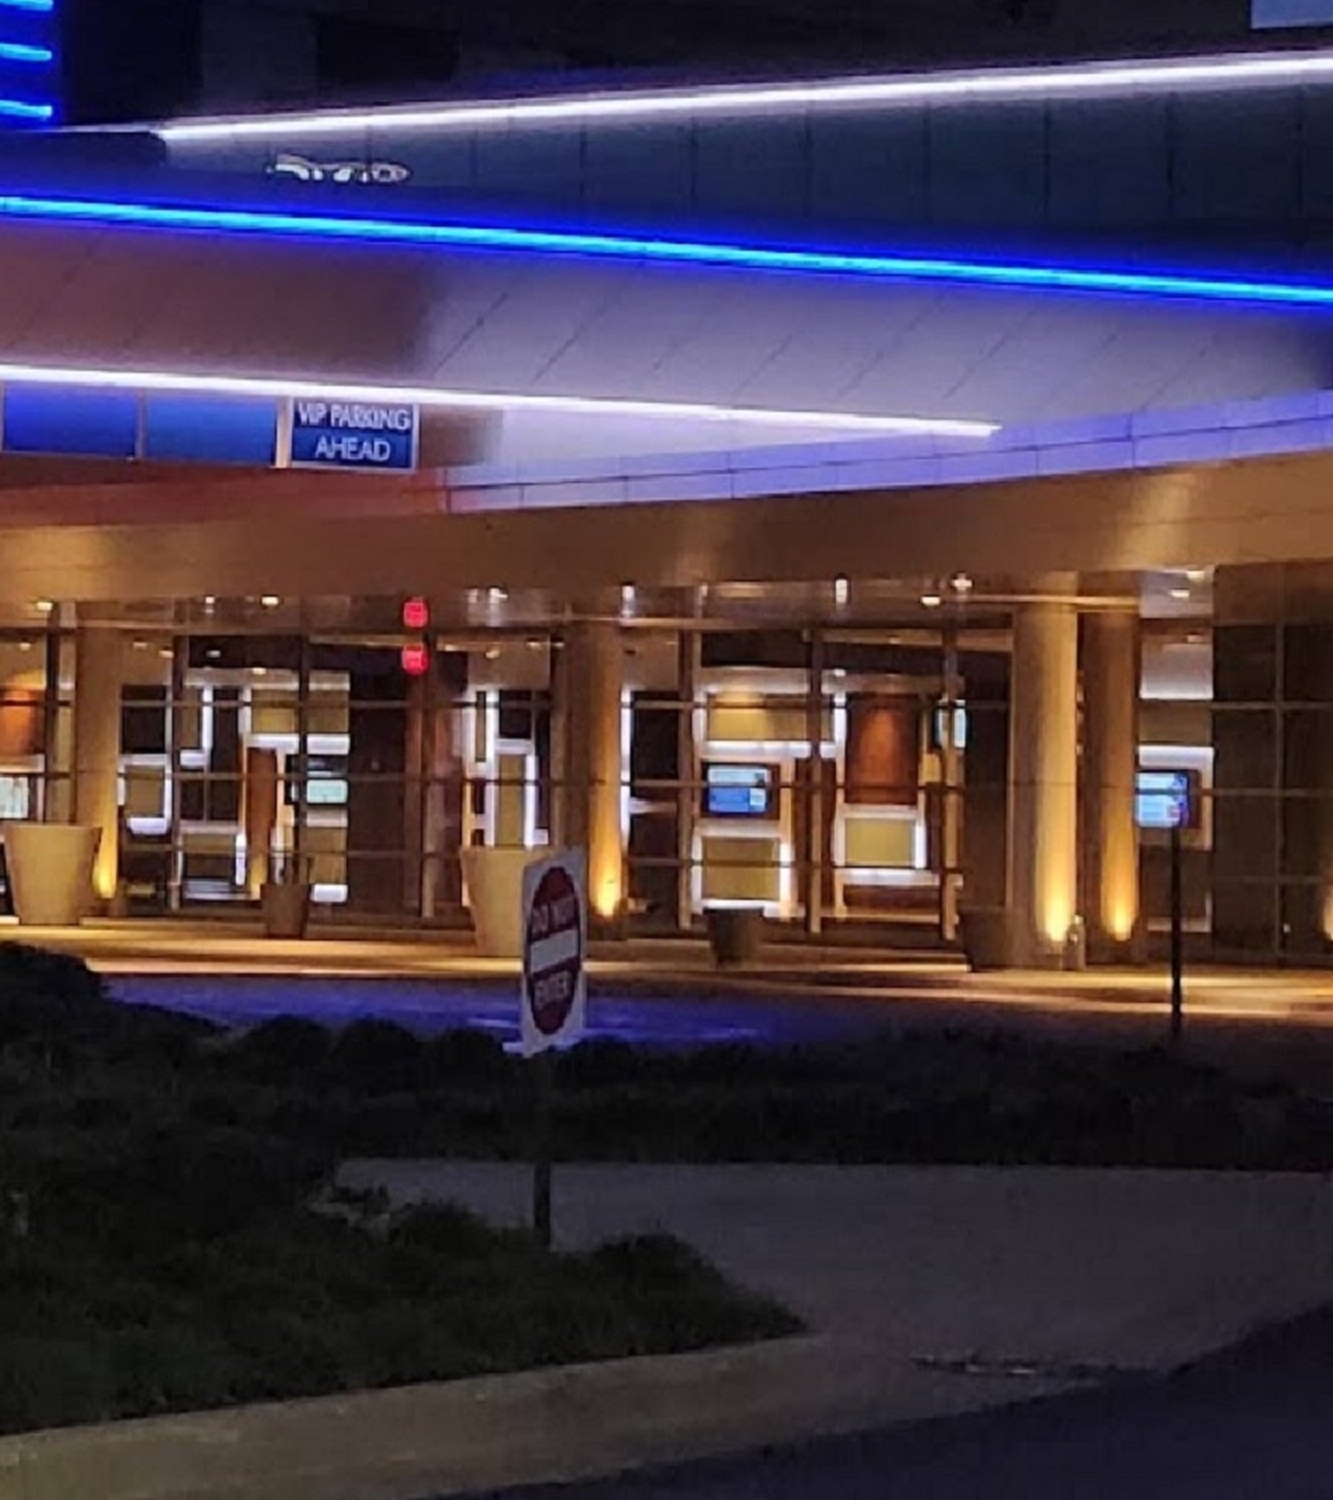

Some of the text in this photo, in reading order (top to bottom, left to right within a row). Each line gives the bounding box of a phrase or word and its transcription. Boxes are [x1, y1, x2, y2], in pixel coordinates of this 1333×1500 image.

[298, 402, 411, 431] VIP PARKING
[315, 435, 391, 462] AHEAD
